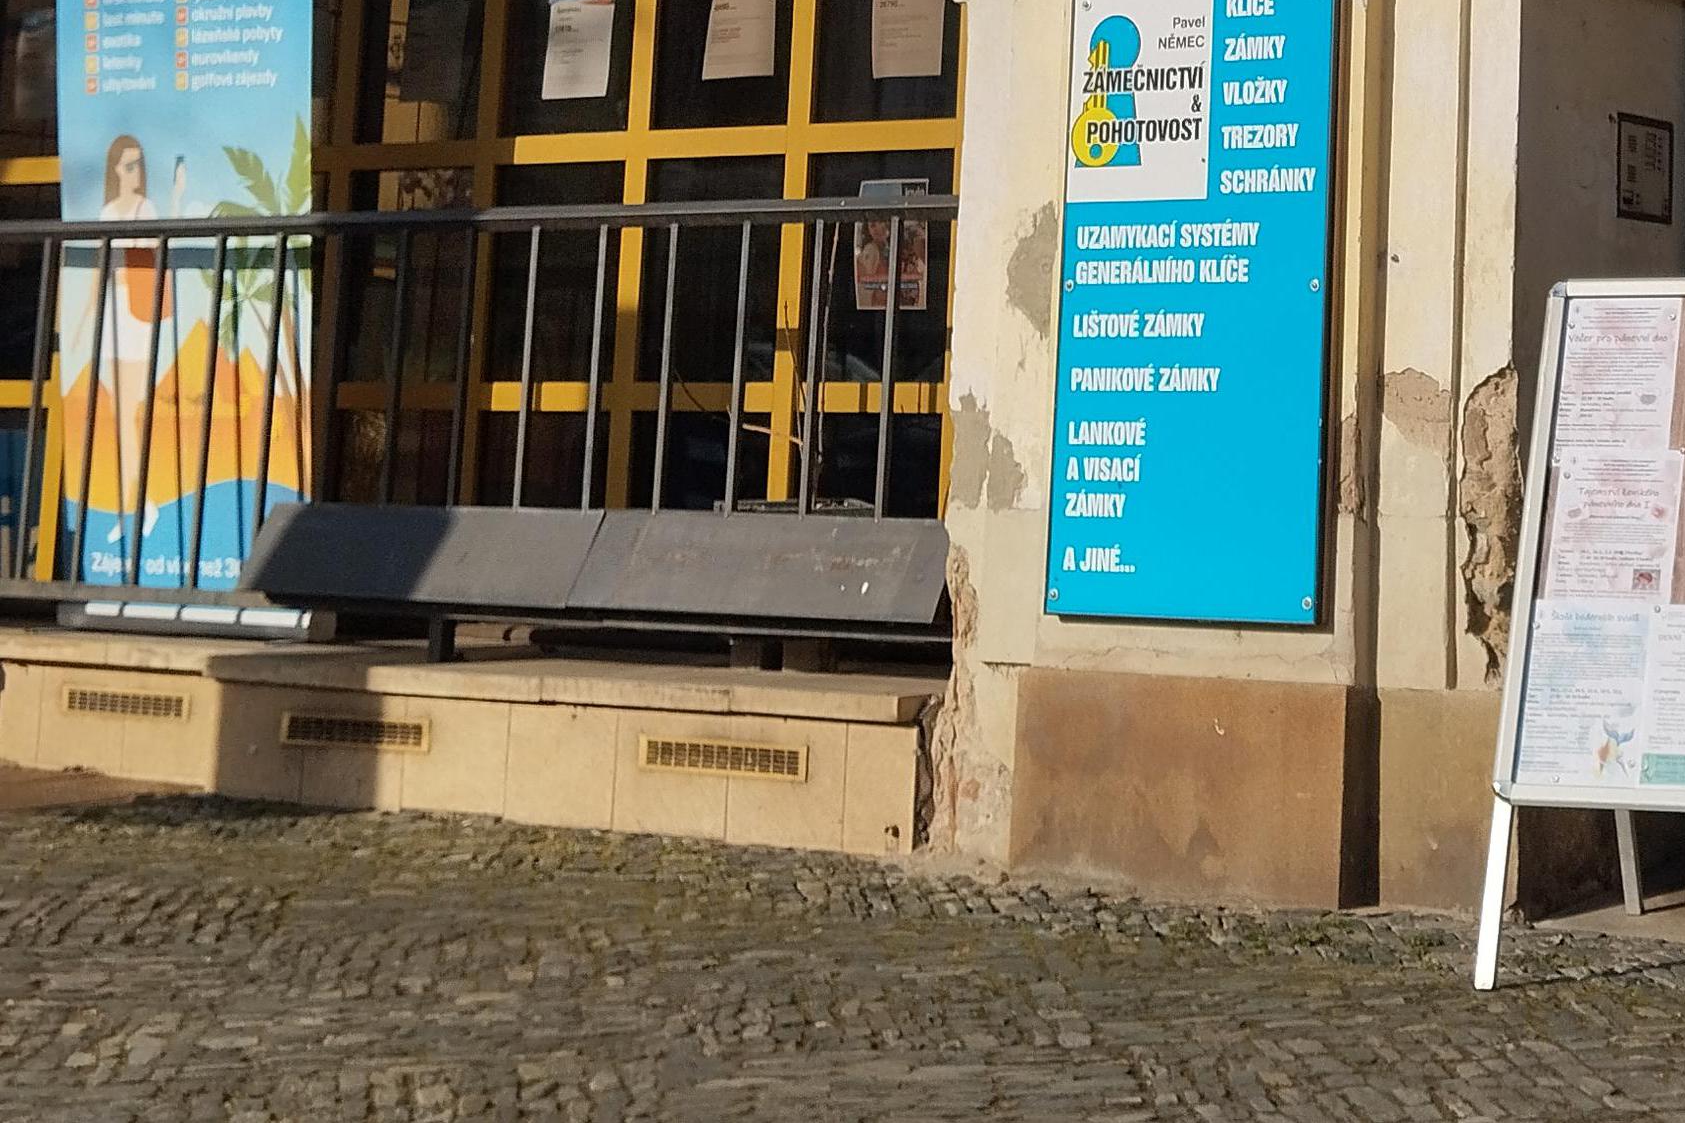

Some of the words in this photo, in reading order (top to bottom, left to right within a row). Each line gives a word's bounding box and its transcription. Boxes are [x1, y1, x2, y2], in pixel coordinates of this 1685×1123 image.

[1172, 17, 1206, 29] Pavel
[1158, 34, 1206, 50] NĚMEC
[1224, 33, 1286, 62] ZÁMKY
[1083, 61, 1206, 94] ZÁMEČNICTVÍ
[1223, 77, 1288, 106] VLOŽKY
[1190, 94, 1202, 113] &
[1087, 117, 1202, 144] POHOTOVOST
[1222, 123, 1299, 150] TREZORY
[1220, 166, 1316, 194] SCHRÁNKY
[1077, 220, 1178, 249] UZAMYKACÍ
[1180, 218, 1260, 248] SYSTÉMY
[1075, 256, 1195, 285] GENERÁLNÍHO
[1199, 254, 1249, 283] KLÍČE
[1073, 310, 1140, 338] LIŠTOVÉ
[1143, 309, 1205, 337] ZÁMKY
[1070, 363, 1155, 392] PANIKOVÉ
[1157, 363, 1221, 392] ZÁMKY
[1068, 417, 1147, 446] LANKOVÉ
[1066, 457, 1080, 482] A
[1084, 454, 1142, 482] VISACÍ
[1064, 489, 1126, 518] ZÁMKY
[1062, 546, 1076, 572] A
[1079, 544, 1136, 573] JINÉ...
